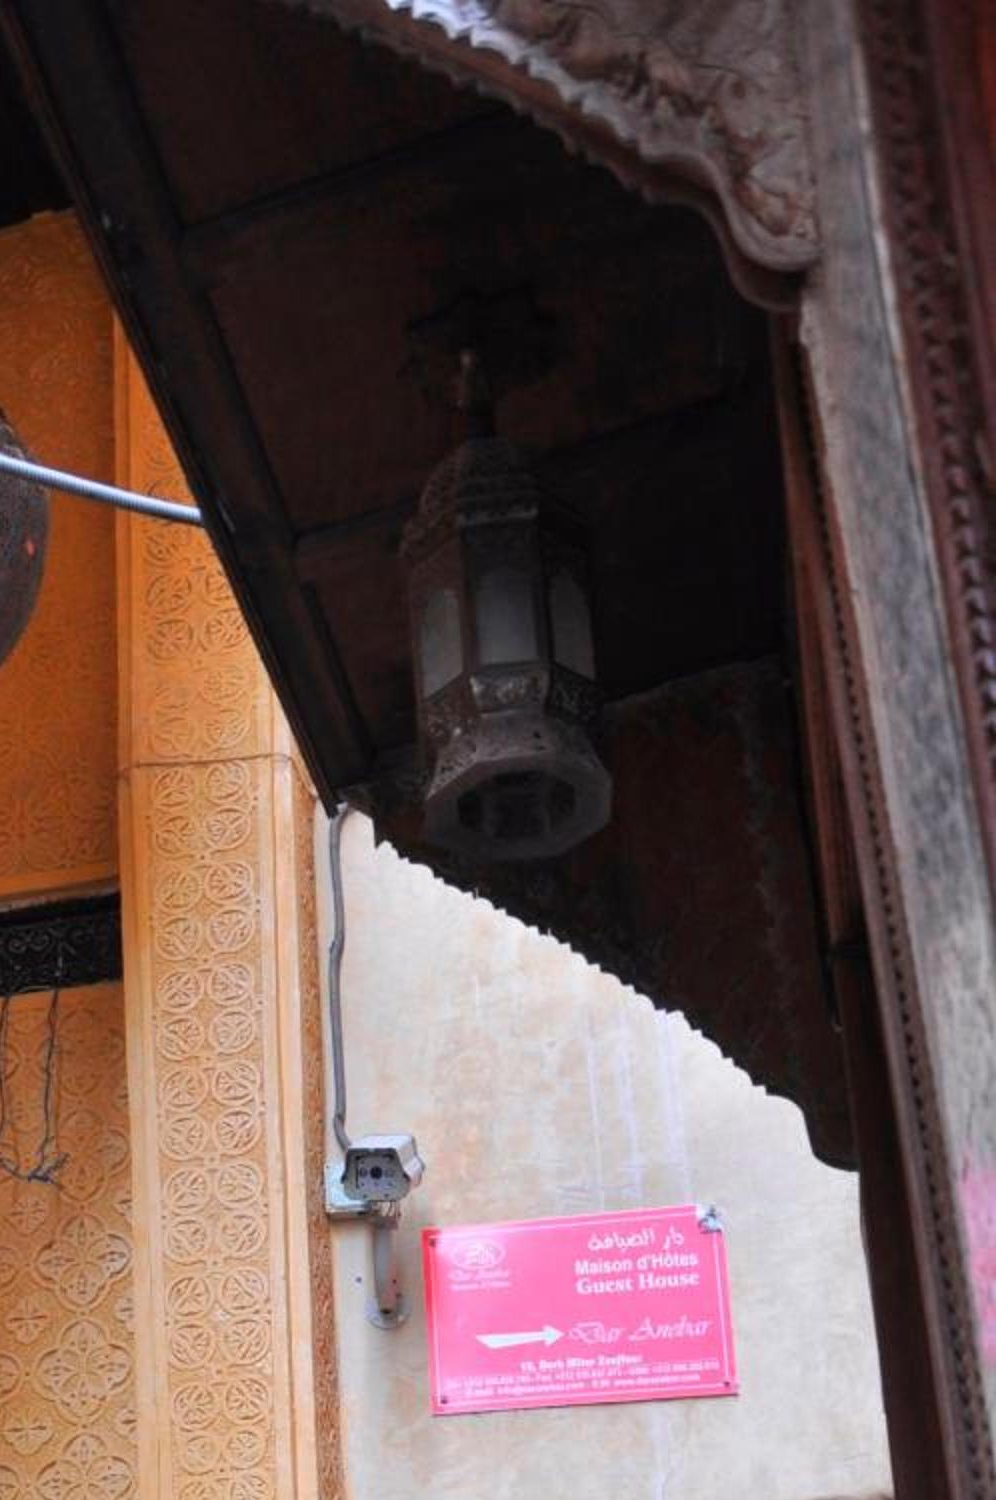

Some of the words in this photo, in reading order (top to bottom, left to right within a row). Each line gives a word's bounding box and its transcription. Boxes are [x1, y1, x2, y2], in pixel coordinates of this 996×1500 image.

[574, 1256, 634, 1276] Maison
[636, 1251, 700, 1271] d'Hôtes
[575, 1277, 634, 1295] Guest
[638, 1271, 701, 1290] House
